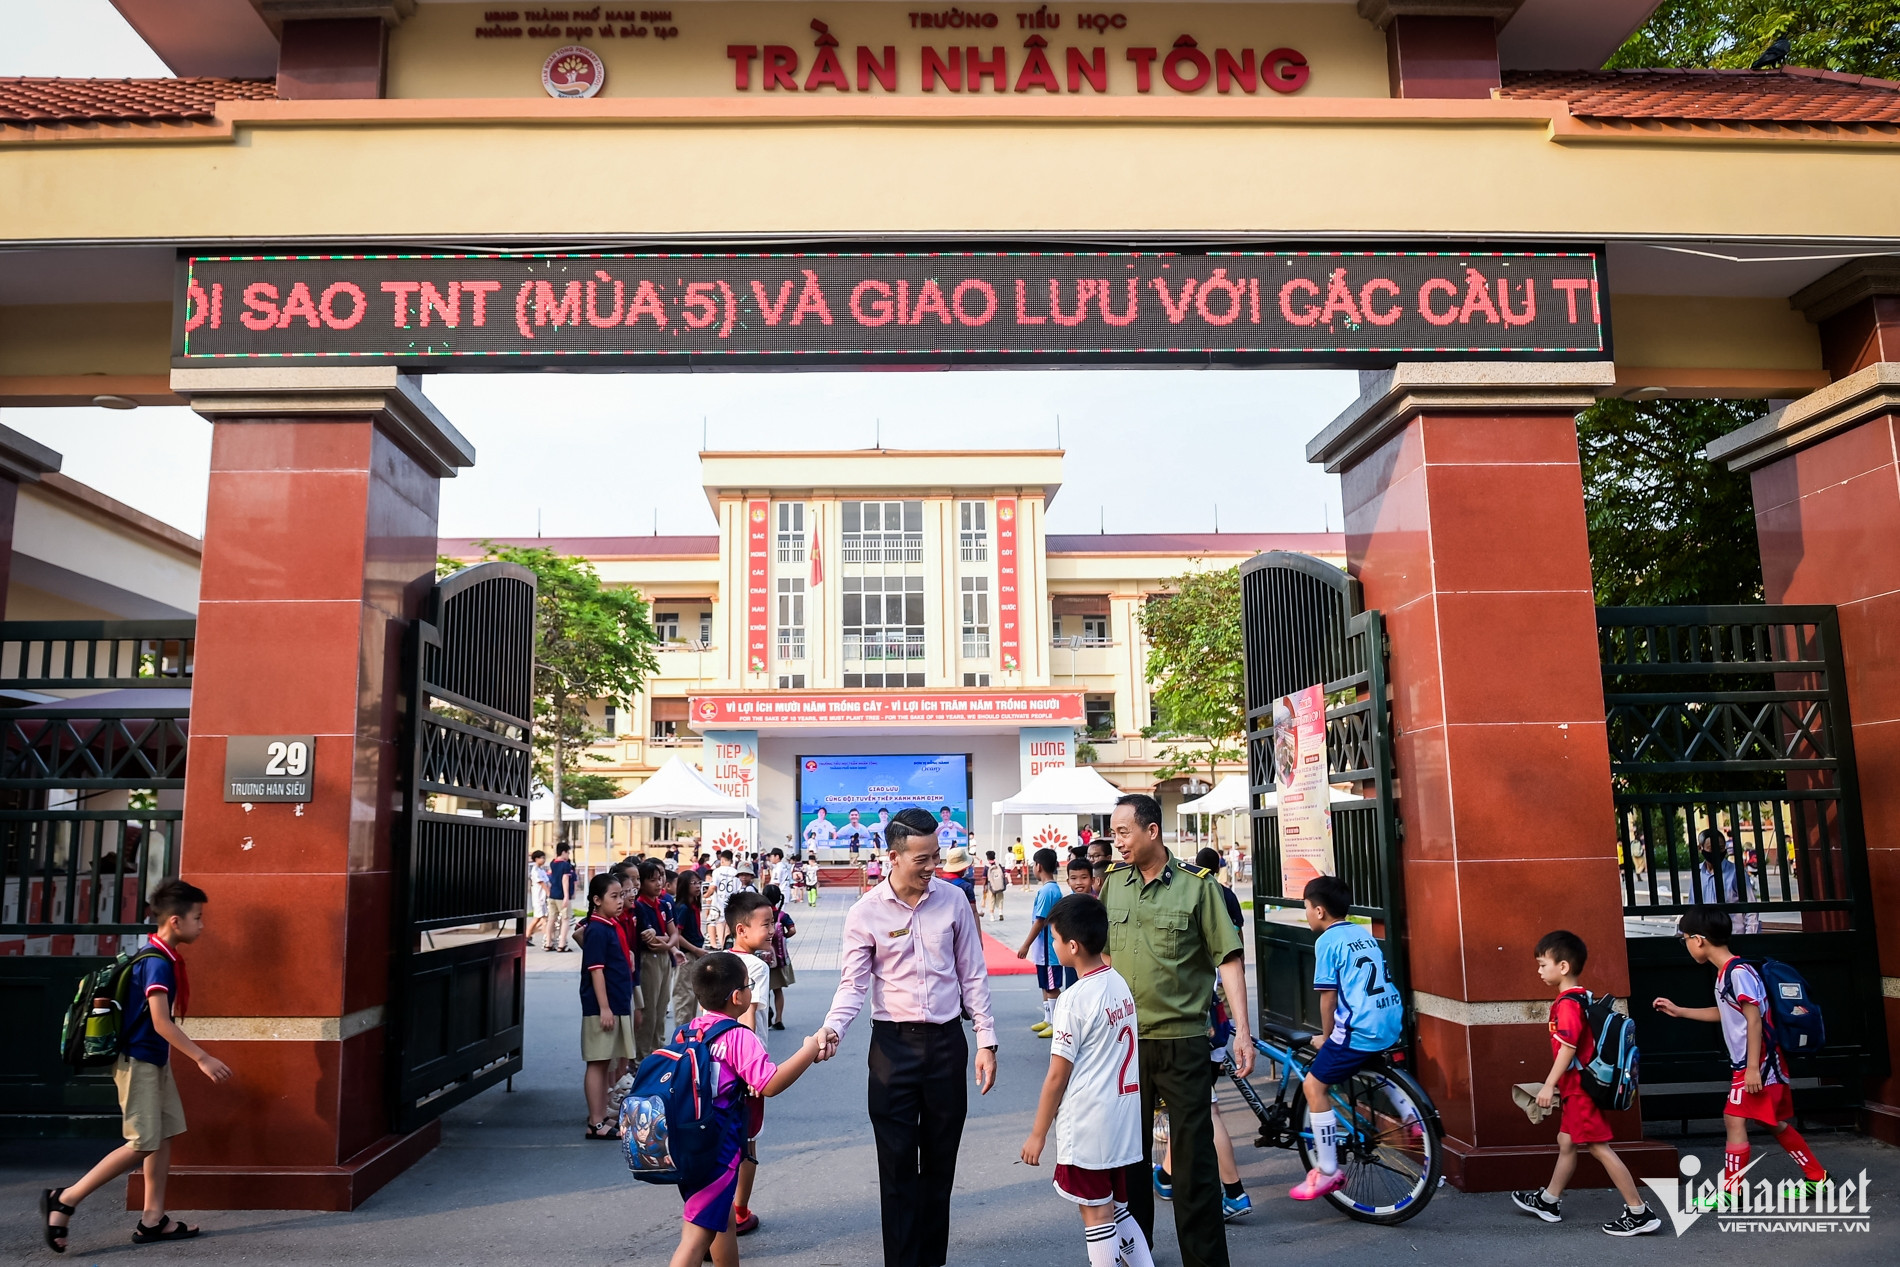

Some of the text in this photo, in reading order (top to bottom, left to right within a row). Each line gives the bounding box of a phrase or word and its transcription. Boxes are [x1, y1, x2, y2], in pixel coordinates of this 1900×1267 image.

[605, 11, 636, 22] NAM
[909, 5, 1127, 34] TRƯỜNG TIỂU HỌC
[599, 24, 616, 38] VÀ
[653, 27, 680, 40] TẠO
[727, 18, 1310, 94] TRẦN NHÂN TÔNG
[240, 282, 366, 331] SAO
[381, 280, 500, 328] TNT
[515, 270, 668, 339] (MÙA
[682, 279, 737, 339] 5)
[750, 270, 834, 326] VÀ
[848, 279, 998, 327] GIAO
[1015, 278, 1139, 327] LƯU
[1150, 268, 1261, 327] VỚI
[1280, 269, 1403, 328] CÁC
[726, 701, 736, 712] VÌ
[738, 701, 754, 714] LỢI
[756, 701, 773, 712] ÍCH
[775, 701, 801, 712] MƯỜI
[803, 701, 827, 712] NĂM
[863, 700, 882, 711] CÂY
[891, 700, 900, 711] VÌ
[903, 701, 919, 713] LỢI
[921, 699, 938, 711] ÍCH
[940, 699, 968, 711] TRĂM
[970, 699, 993, 711] NĂM
[1030, 698, 1060, 710] NGƯỜI
[716, 742, 741, 758] TIẾP
[265, 741, 307, 776] 29
[286, 781, 306, 795] SIÊU
[719, 878, 734, 893] 66
[1376, 997, 1390, 1010] 4A1
[1117, 1023, 1140, 1097] 2
